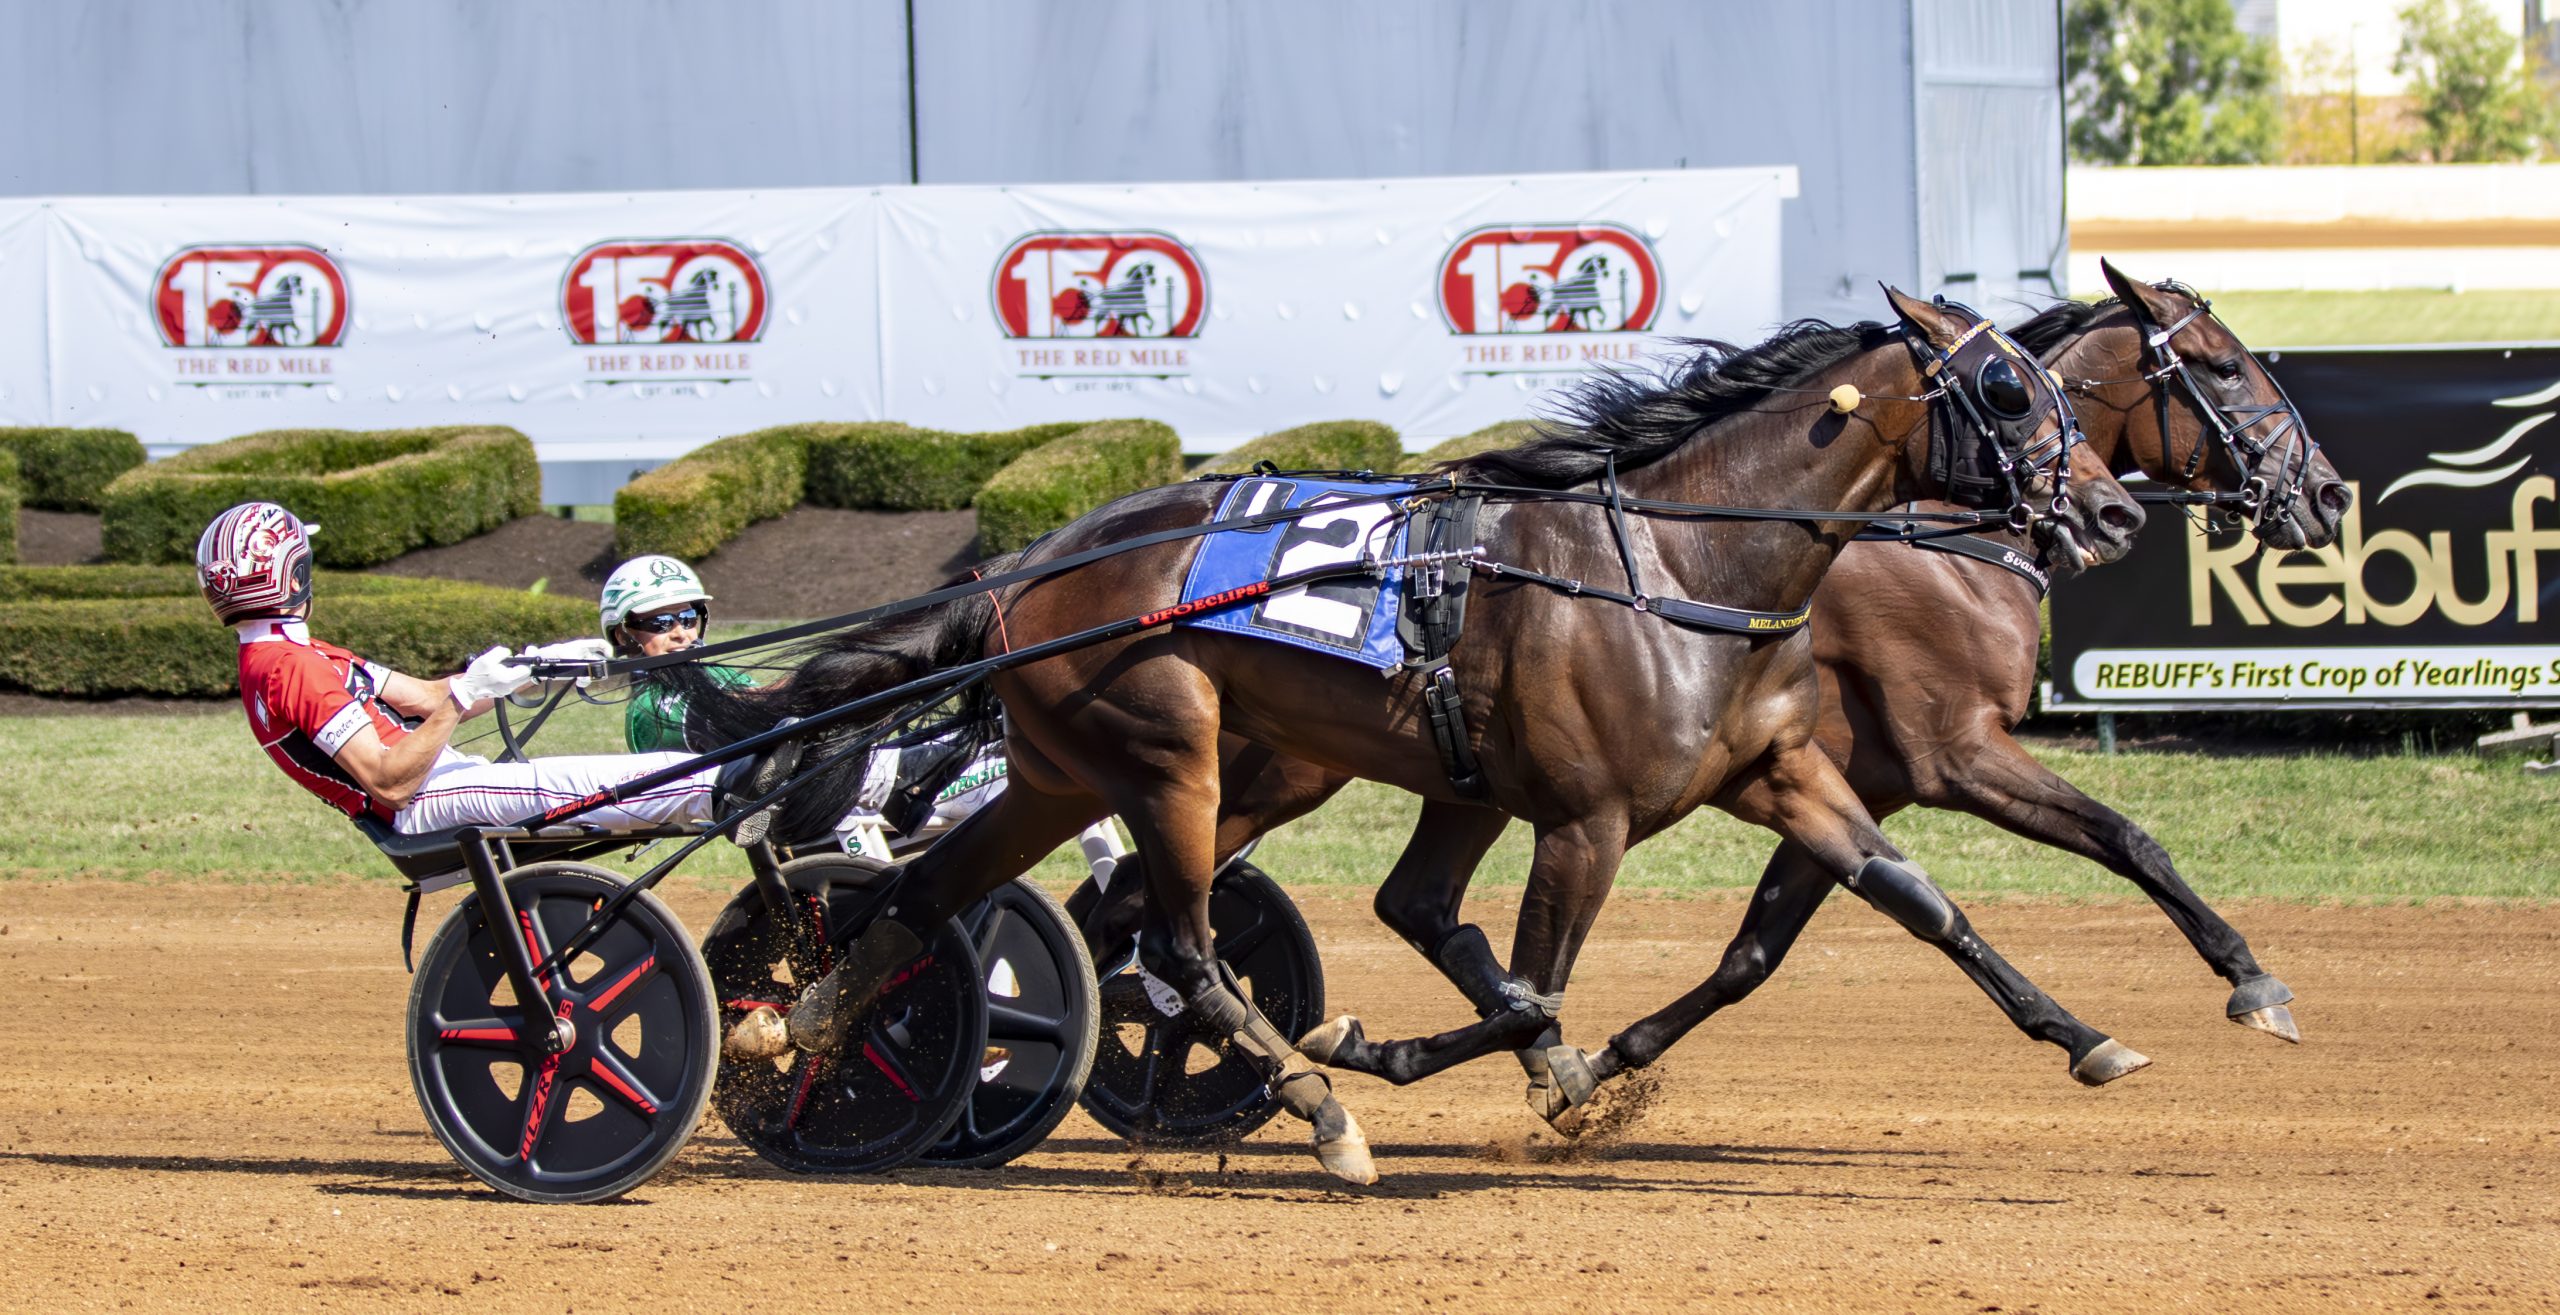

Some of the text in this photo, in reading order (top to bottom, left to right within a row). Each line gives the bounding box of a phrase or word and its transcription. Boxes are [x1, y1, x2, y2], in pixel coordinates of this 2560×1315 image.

[170, 260, 335, 346] 150
[578, 255, 752, 342] 150
[1012, 247, 1191, 337] 150
[1457, 241, 1644, 333] 150
[175, 357, 332, 374] THE RED MILE
[585, 353, 750, 371] THE RED MILE
[1017, 349, 1188, 366] THE RED MILE
[1464, 343, 1640, 362] THE RED MILE
[2231, 661, 2293, 687] First
[2299, 660, 2367, 693] Crop
[2375, 659, 2407, 686] of
[2412, 658, 2541, 692] Yearlings
